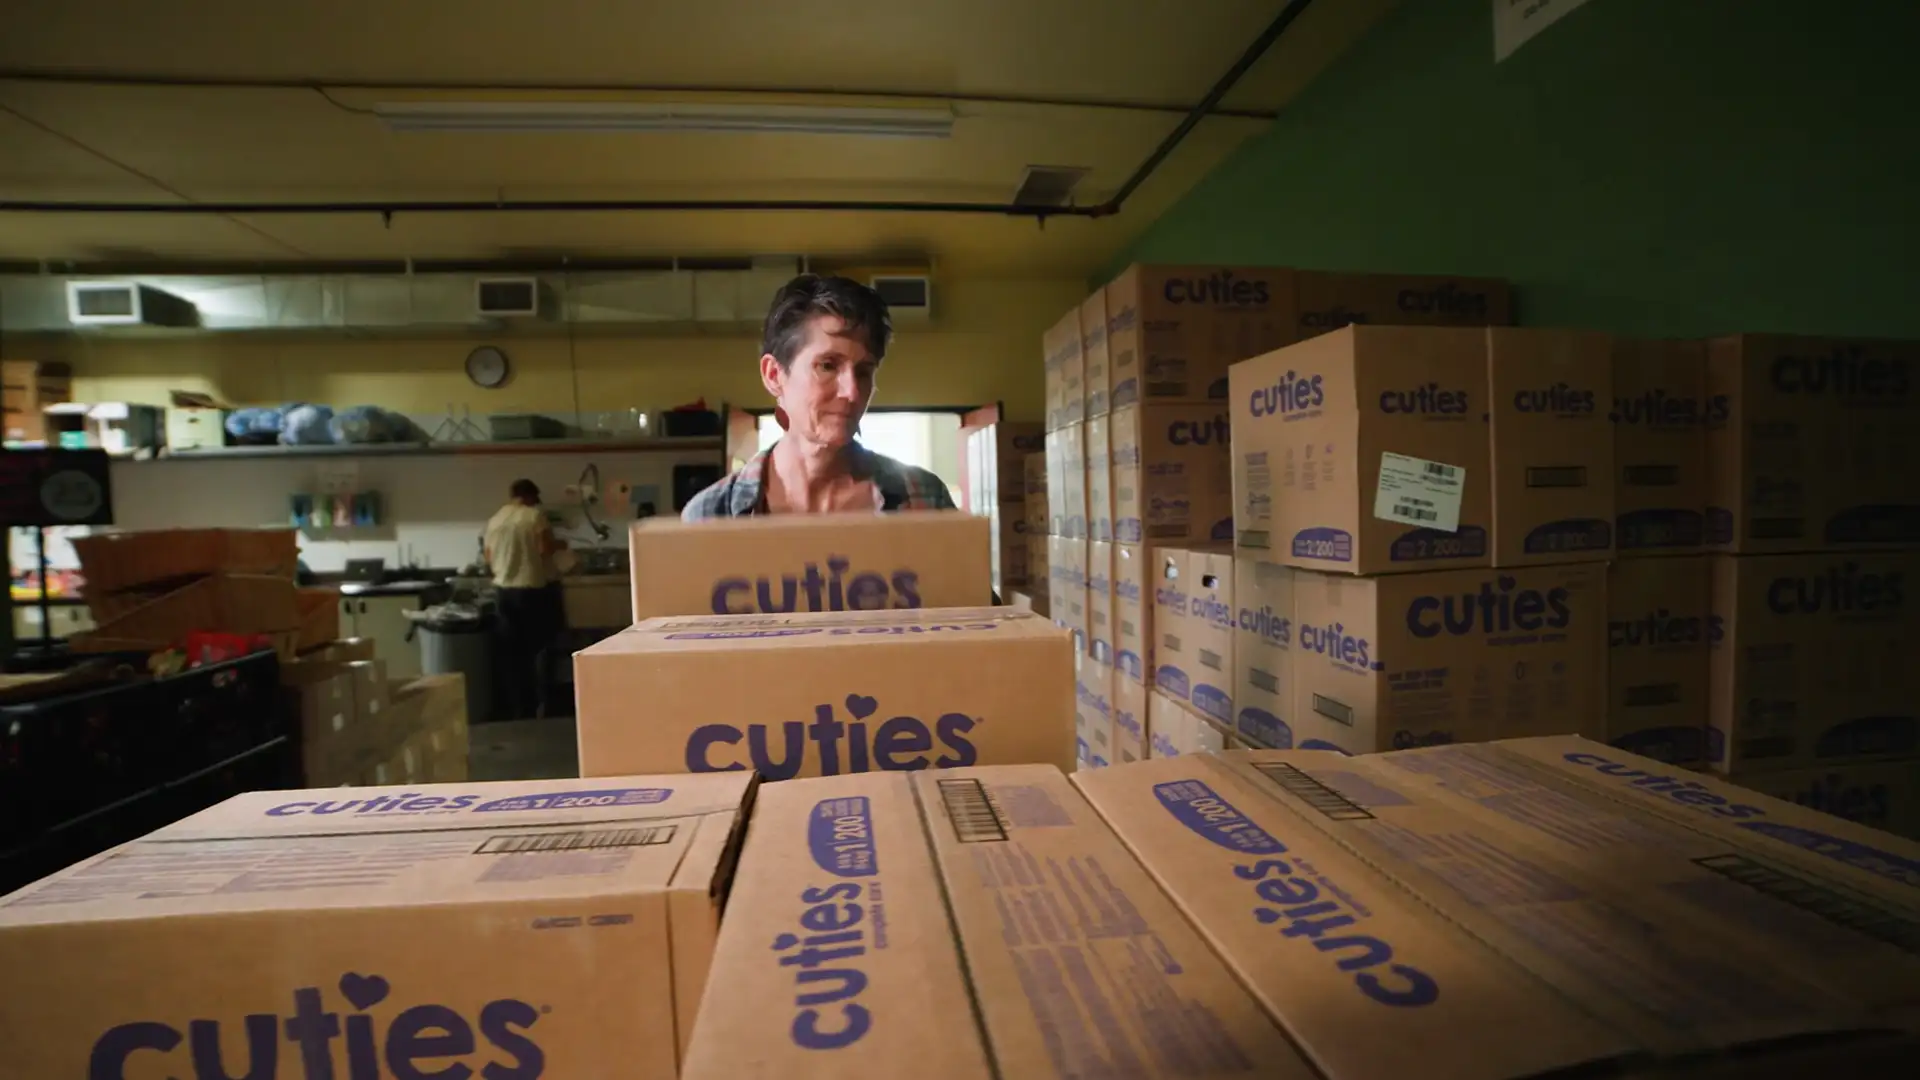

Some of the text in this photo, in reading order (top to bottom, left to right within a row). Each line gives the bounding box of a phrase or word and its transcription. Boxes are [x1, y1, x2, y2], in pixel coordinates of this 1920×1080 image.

[1164, 268, 1269, 304] cuties
[1398, 283, 1488, 317] cuties
[1772, 346, 1909, 394] cuties
[1250, 369, 1323, 417] cuties
[1380, 382, 1468, 414] cuties
[1514, 382, 1595, 414] cuties
[1316, 541, 1334, 556] 200
[1433, 539, 1460, 556] 200
[711, 552, 922, 614] cuties
[1768, 562, 1905, 614] cuties
[1192, 593, 1229, 626] cuties
[1239, 605, 1291, 644] cuties
[1406, 575, 1570, 638] cuties
[1300, 621, 1369, 670] cuties
[685, 694, 978, 781] cuties
[1564, 752, 1765, 818] cuties
[264, 793, 481, 817] cuties
[552, 796, 617, 808] 200
[1189, 797, 1237, 822] 200
[832, 816, 868, 840] 200
[833, 843, 868, 852] 1
[1233, 859, 1440, 1008] cuties
[772, 882, 872, 1051] cuties
[88, 971, 545, 1080] cuties
